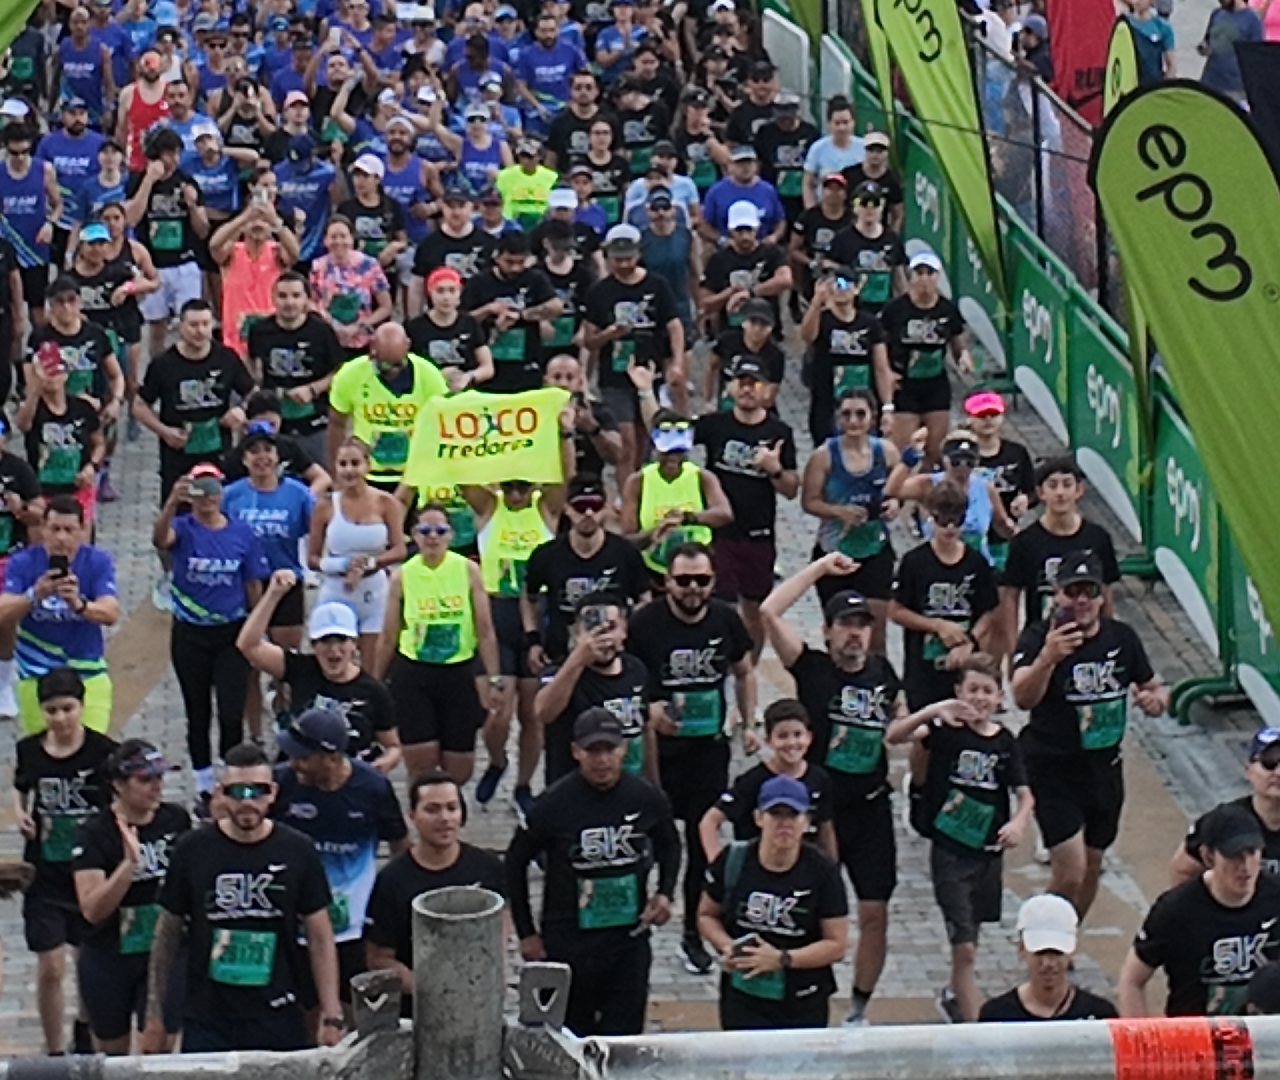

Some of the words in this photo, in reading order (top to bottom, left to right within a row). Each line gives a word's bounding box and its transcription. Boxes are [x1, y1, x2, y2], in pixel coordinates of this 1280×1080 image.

[1135, 124, 1253, 301] epm
[1023, 289, 1053, 364] epm
[438, 407, 538, 439] LOCO
[1086, 365, 1121, 448] epm
[239, 508, 289, 521] TEAM
[1166, 457, 1201, 552] epm
[187, 557, 240, 571] TEAM
[671, 648, 717, 676] 5K
[1073, 661, 1119, 692] 5K
[40, 777, 88, 808] 5K
[581, 825, 637, 860] 5K
[215, 873, 274, 910] 5K
[747, 892, 798, 928] 5K
[1214, 933, 1269, 973] 5K
